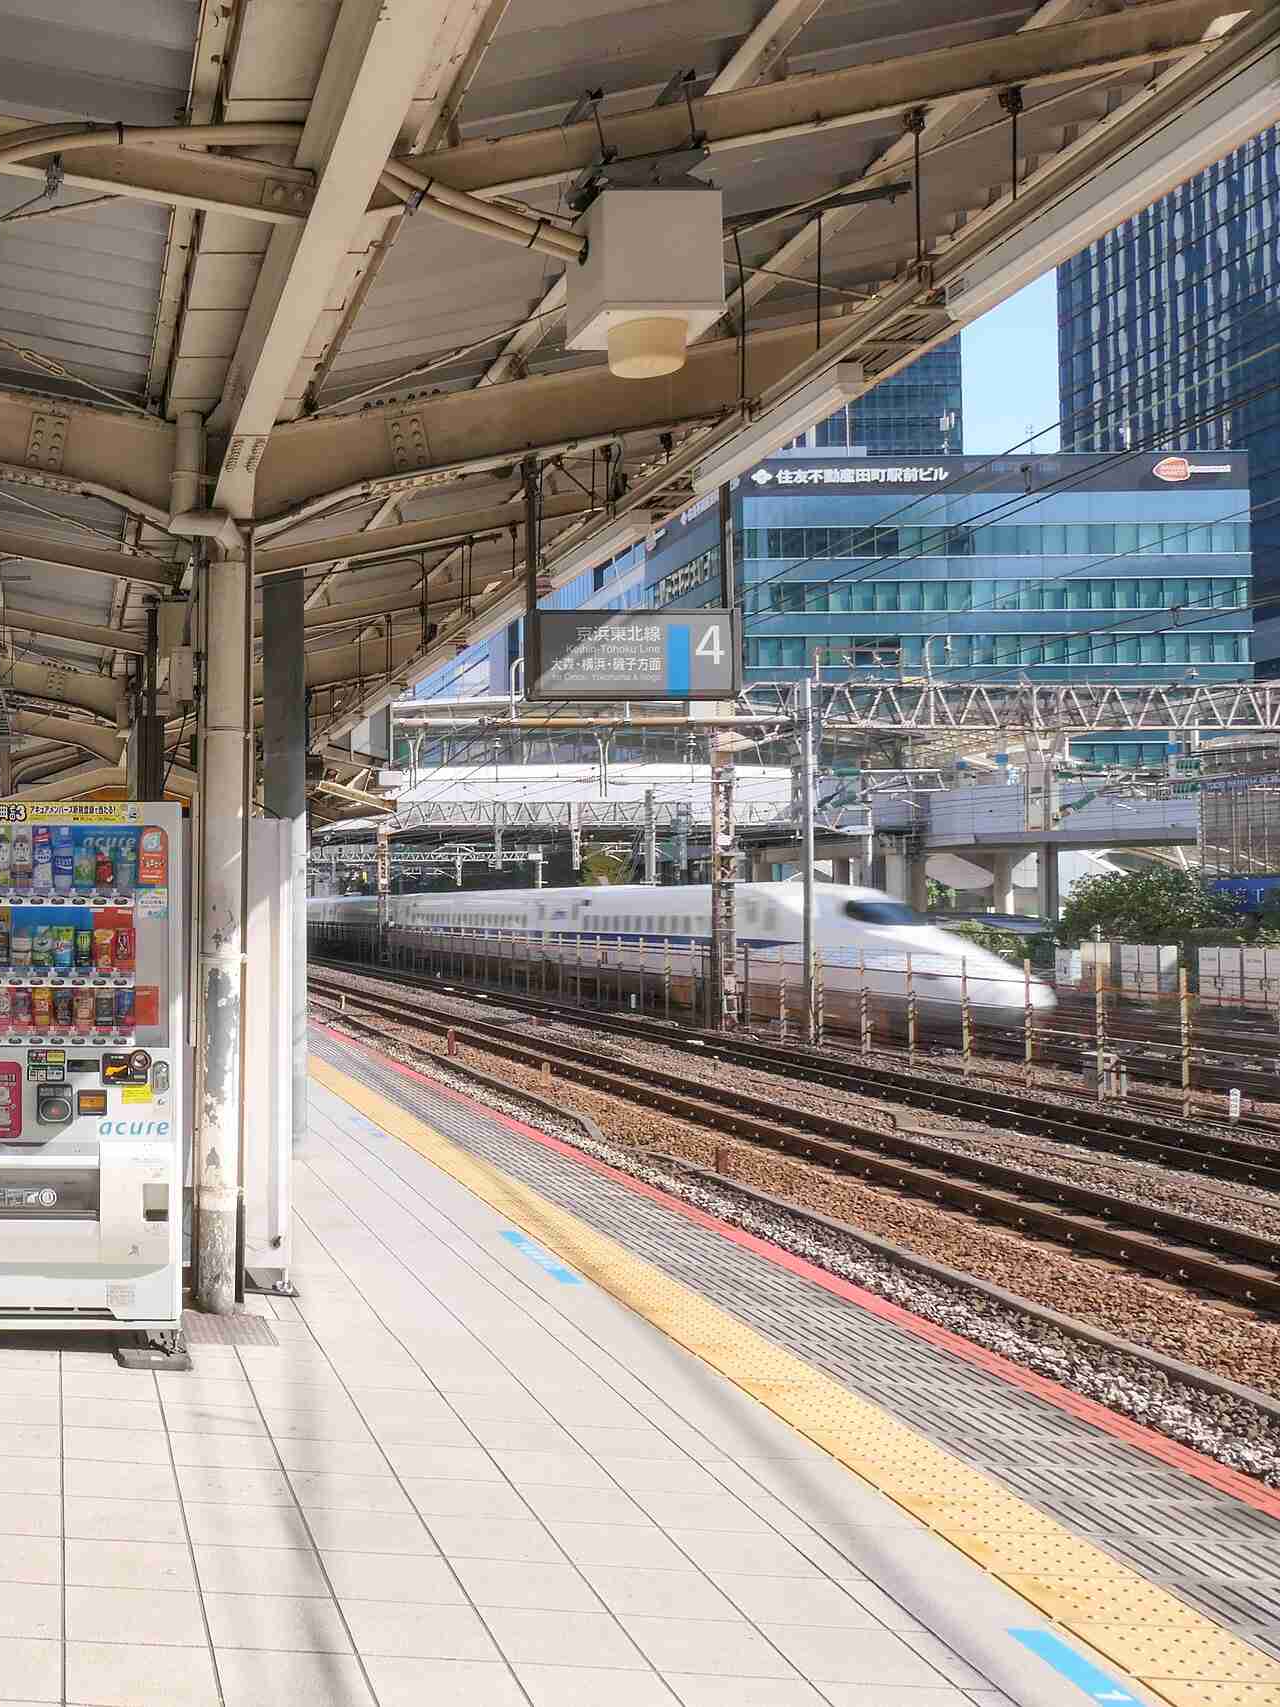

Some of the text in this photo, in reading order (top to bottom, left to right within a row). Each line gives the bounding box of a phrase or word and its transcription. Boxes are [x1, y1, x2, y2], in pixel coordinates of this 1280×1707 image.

[576, 625, 661, 642] 京浜東北線
[695, 624, 725, 665] 4
[99, 1119, 169, 1136] acure
